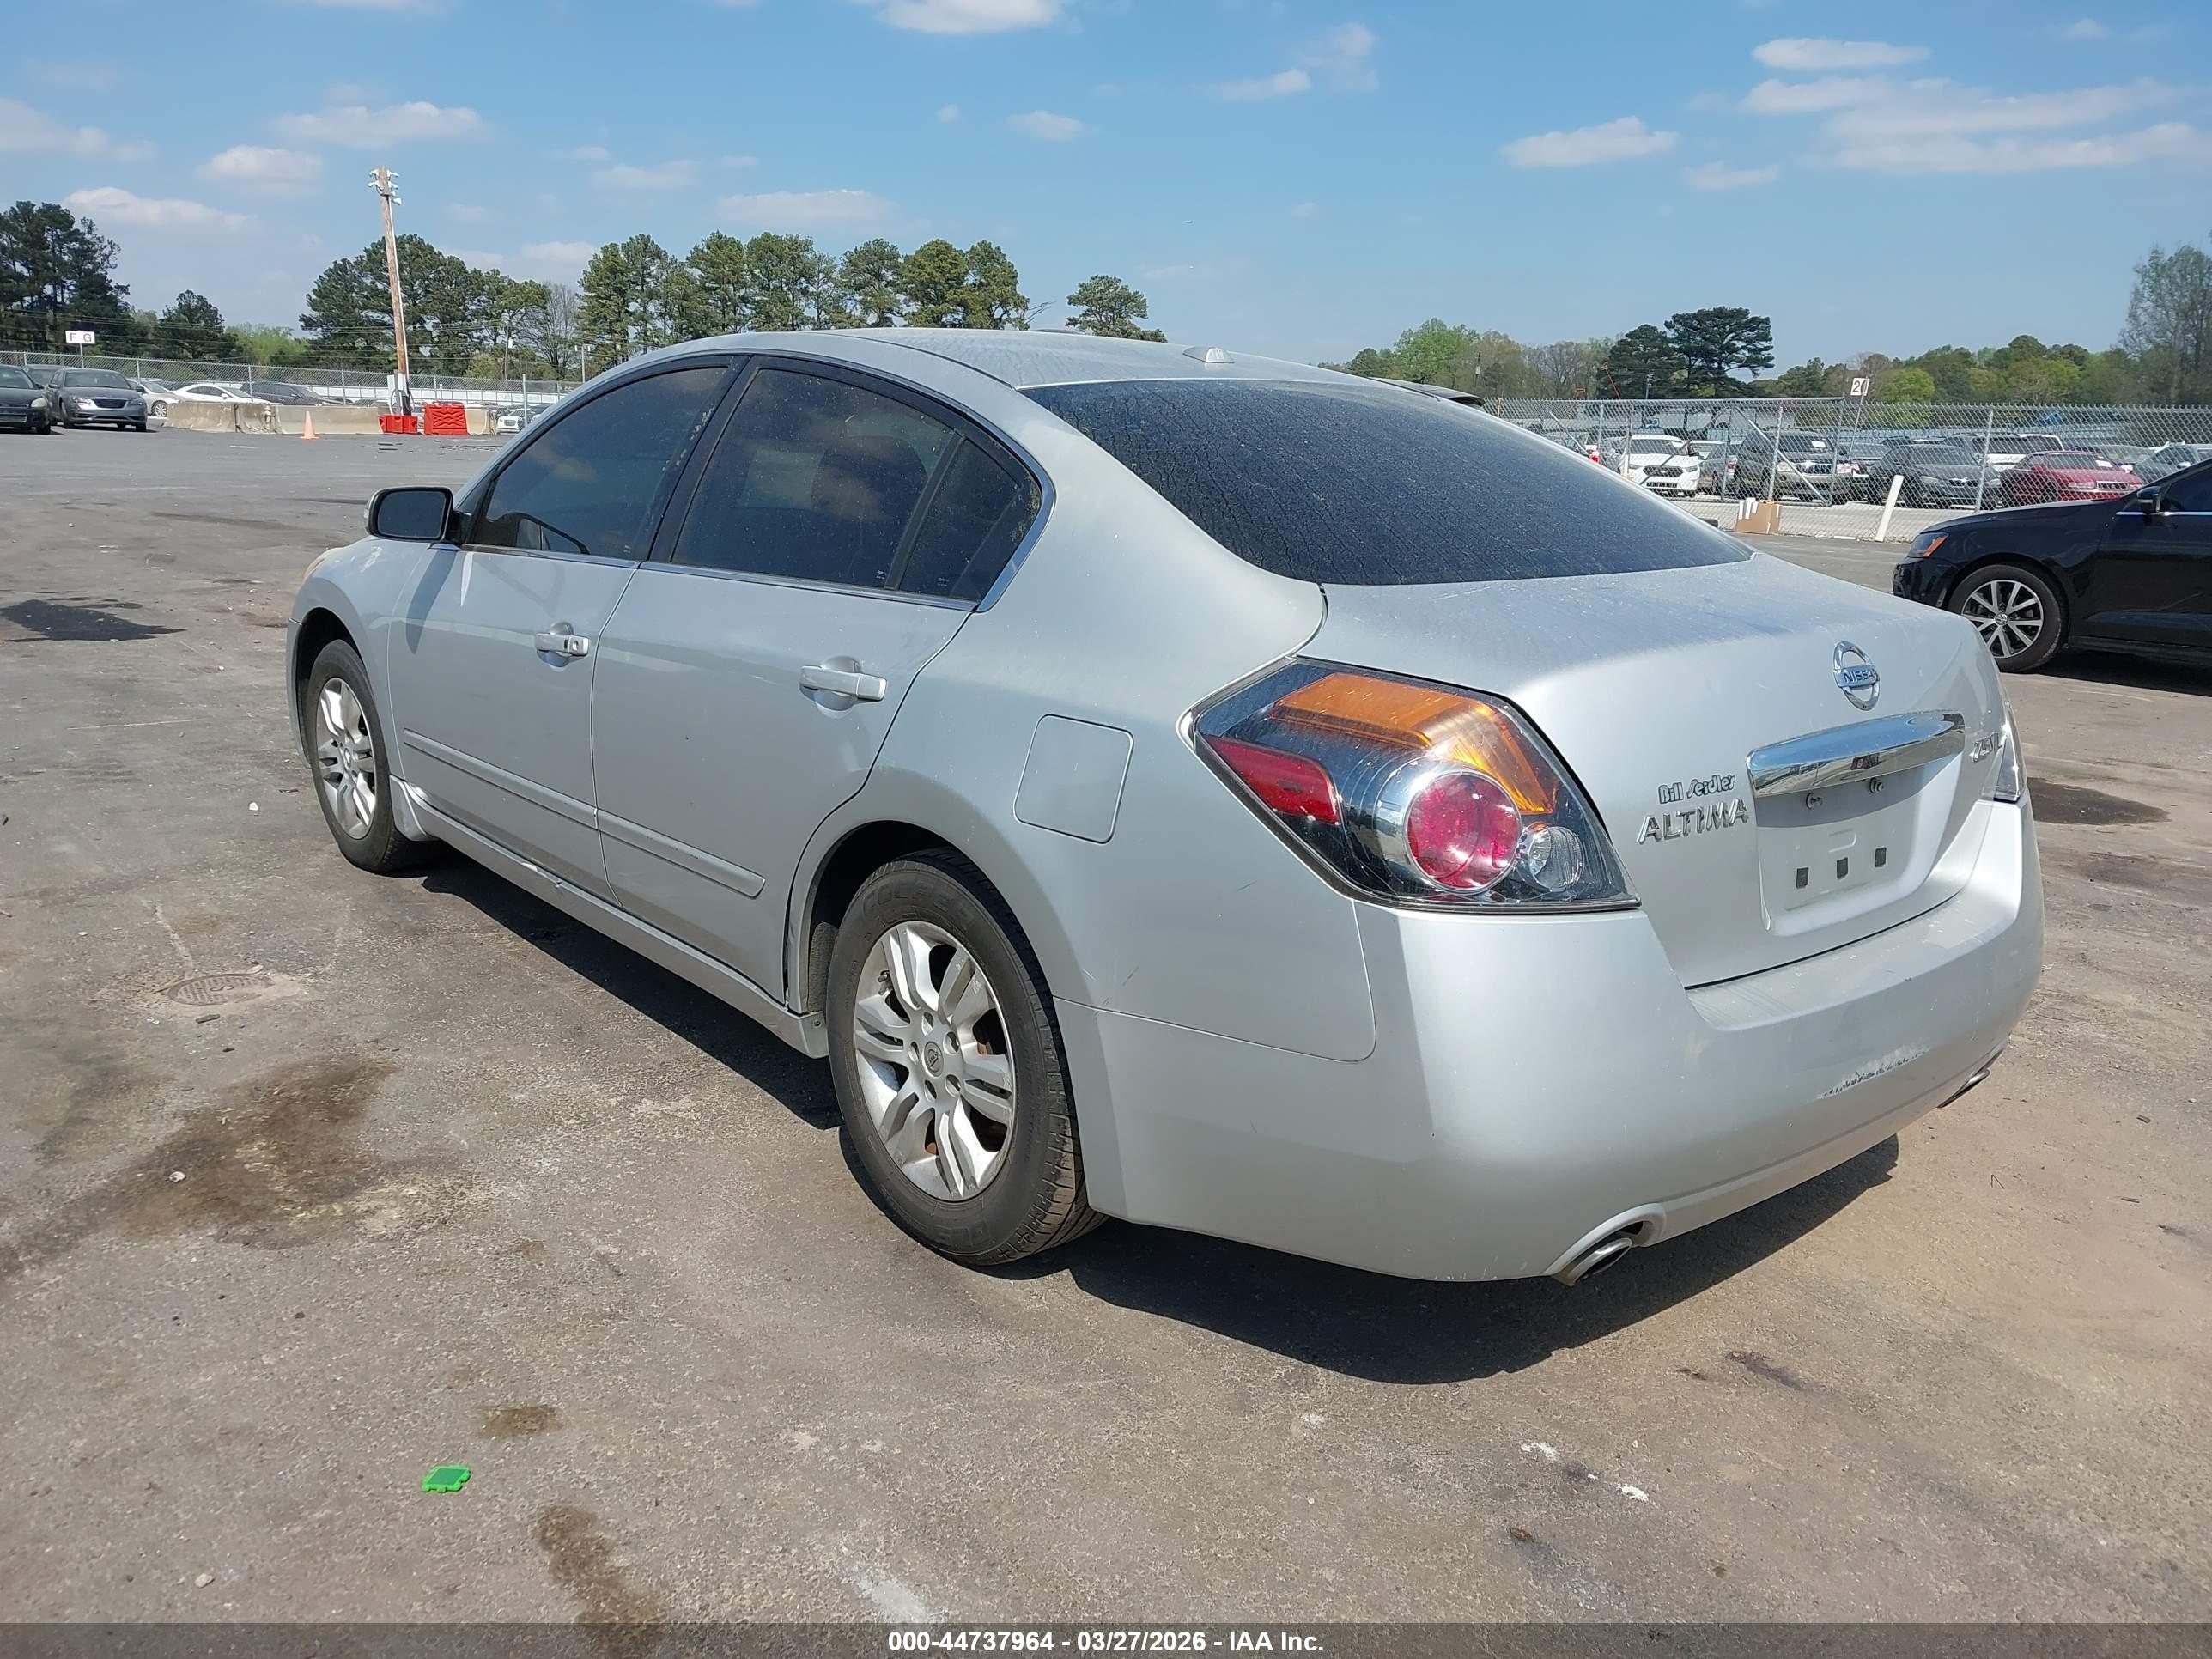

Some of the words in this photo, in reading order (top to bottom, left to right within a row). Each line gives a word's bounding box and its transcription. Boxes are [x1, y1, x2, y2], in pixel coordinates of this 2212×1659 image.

[70, 332, 76, 342] F
[82, 333, 92, 343] G
[1842, 669, 1877, 683] NISSA
[1658, 782, 1684, 804] Bill
[1635, 798, 1749, 845] ALTIMA
